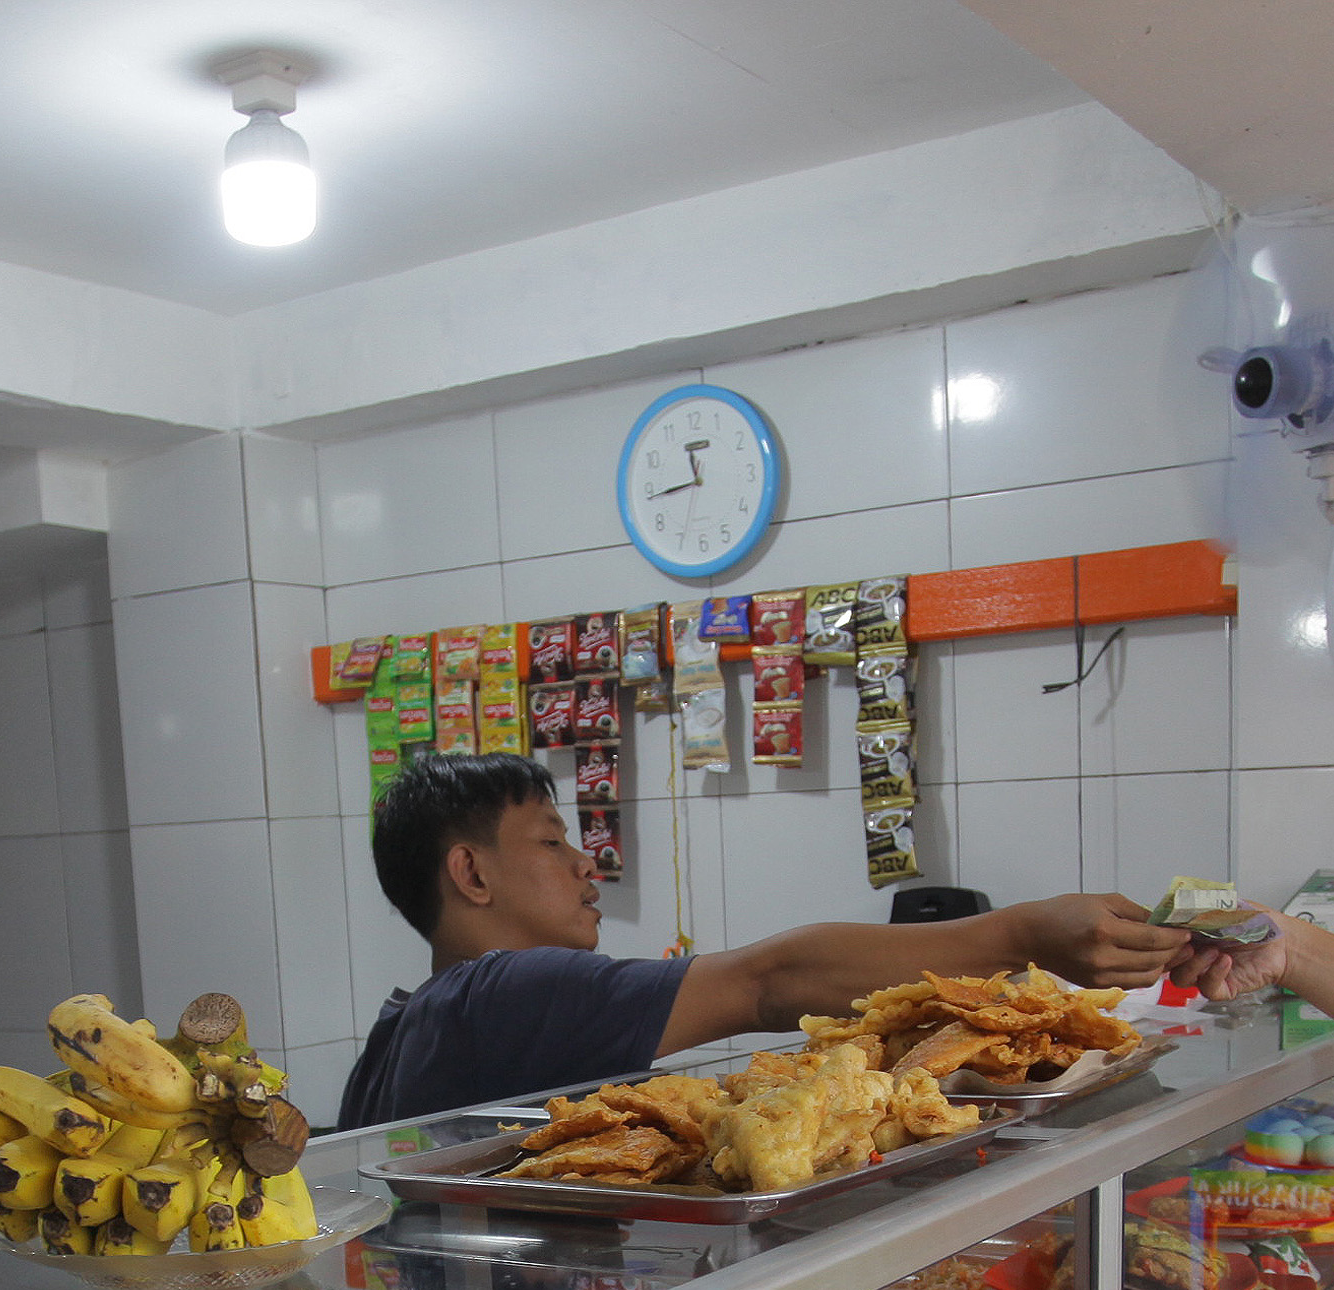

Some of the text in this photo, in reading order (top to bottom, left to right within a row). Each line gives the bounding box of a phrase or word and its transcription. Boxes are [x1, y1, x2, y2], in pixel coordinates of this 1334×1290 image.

[687, 411, 702, 430] 12
[714, 413, 720, 431] 1
[663, 423, 675, 442] 11
[736, 431, 746, 451] 2
[646, 450, 660, 469] 10
[746, 463, 756, 482] 3
[738, 497, 748, 514] 4
[655, 512, 665, 532] 8
[675, 532, 685, 551] 7
[699, 533, 709, 553] 6
[720, 524, 731, 543] 5
[810, 588, 857, 606] ABC
[856, 625, 897, 645] ABC
[859, 704, 897, 720] ABC
[862, 779, 904, 800] ABC
[868, 854, 909, 875] ABC
